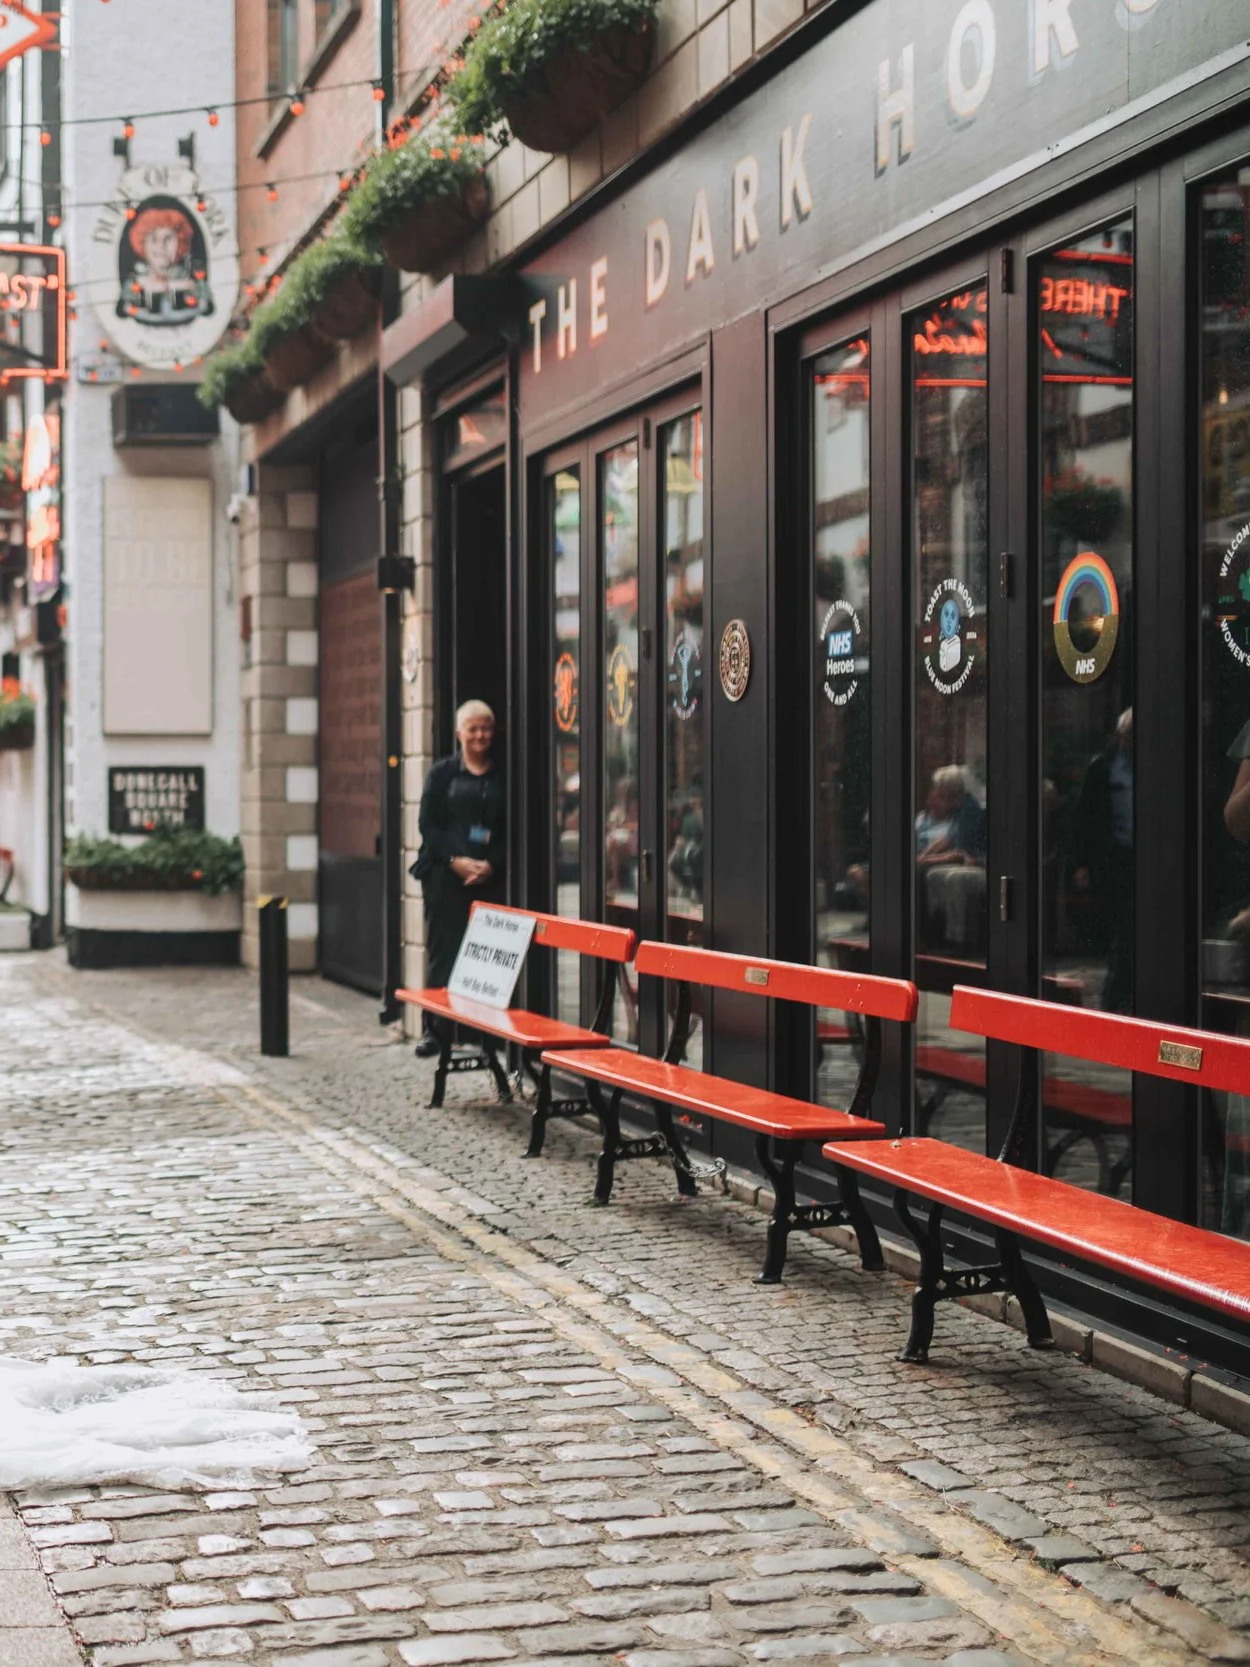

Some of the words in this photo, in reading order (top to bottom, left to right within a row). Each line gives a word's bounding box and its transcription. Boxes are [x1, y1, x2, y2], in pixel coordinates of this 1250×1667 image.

[529, 255, 610, 374] THE
[644, 112, 814, 306] DARK
[875, 0, 1155, 173] HOR
[1219, 523, 1250, 577] WELCOM
[925, 583, 942, 622] TOAST
[943, 579, 957, 591] THE
[957, 581, 976, 618] MOON
[835, 600, 854, 617] THANKS
[852, 612, 861, 635] YOU
[829, 632, 852, 656] NHS
[826, 658, 854, 676] Heroes
[924, 655, 936, 683] BLUE
[934, 678, 951, 694] MOON
[951, 654, 975, 694] FESTIVAL
[1075, 658, 1095, 675] NHS
[824, 681, 835, 703] ONE
[834, 693, 847, 706] AND
[847, 679, 857, 700] ALL
[464, 942, 493, 963] STRICTLY
[490, 949, 519, 971] PRIVATE
